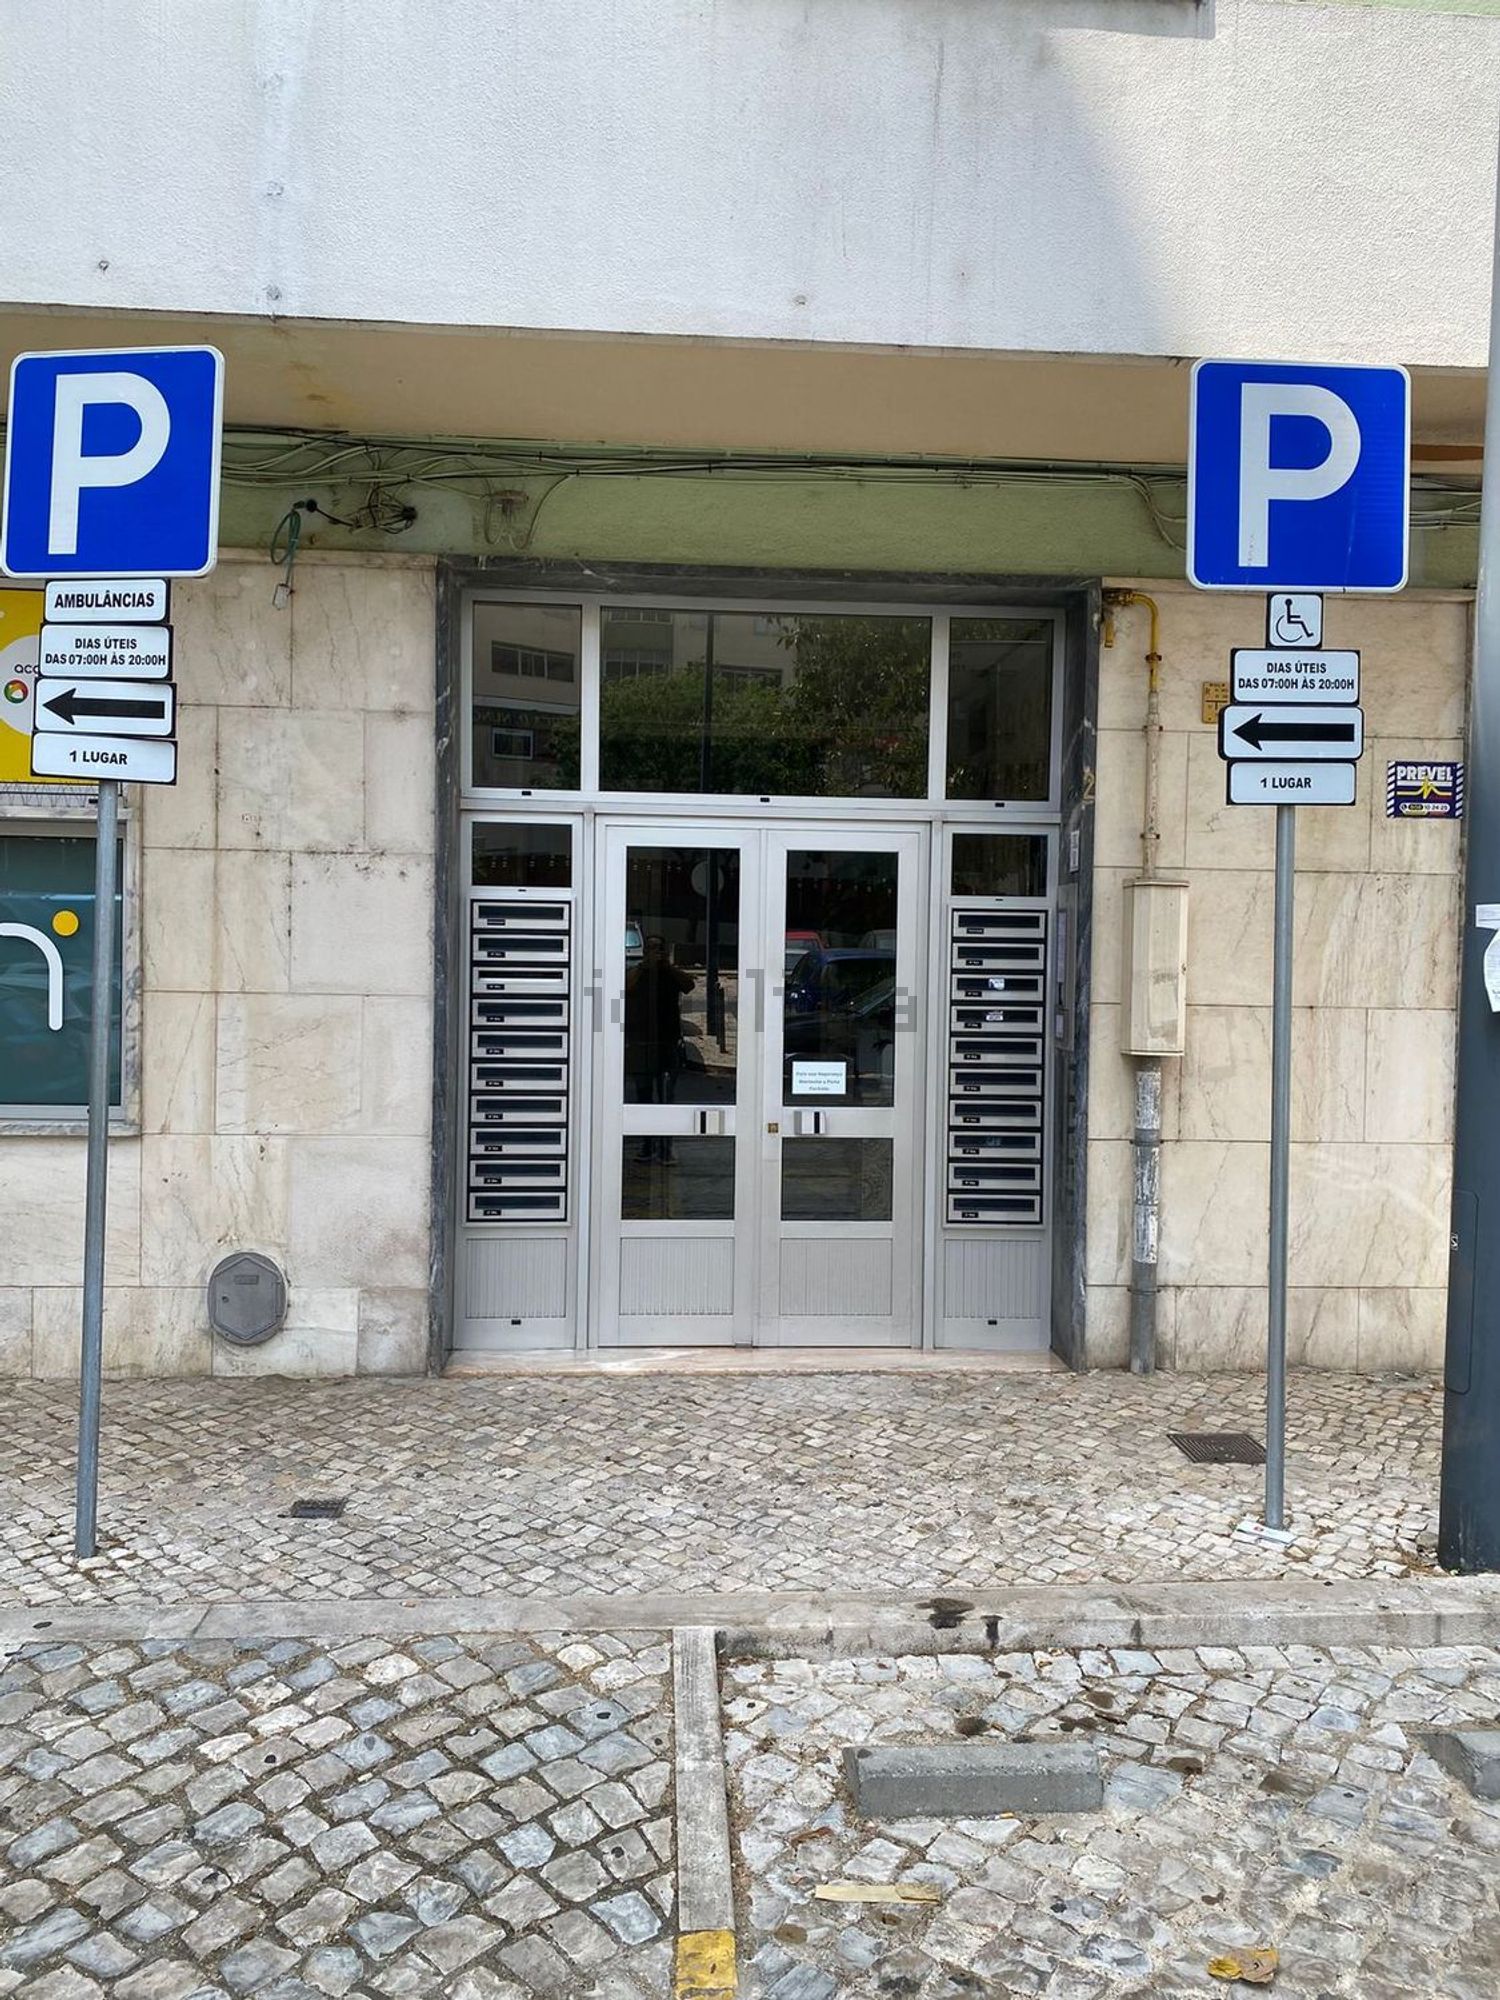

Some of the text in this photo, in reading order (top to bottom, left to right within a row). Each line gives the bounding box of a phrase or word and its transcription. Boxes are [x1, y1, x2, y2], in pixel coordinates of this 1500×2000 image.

[48, 372, 170, 554] P
[1239, 383, 1361, 567] P
[54, 589, 155, 609] AMBULÂNCIAS
[74, 636, 138, 650] DIAS ÚTEIS
[44, 653, 67, 665] DAS
[68, 653, 108, 666] 07:00H
[128, 654, 167, 666] 20:00H
[1266, 659, 1327, 674] DIAS ÚTEIS
[1238, 675, 1355, 690] DAS 07:00H ÀS 20:00H
[69, 750, 128, 766] 1 LUGAR
[1396, 765, 1453, 781] PREVEL
[1260, 776, 1312, 789] 1 LUGAR
